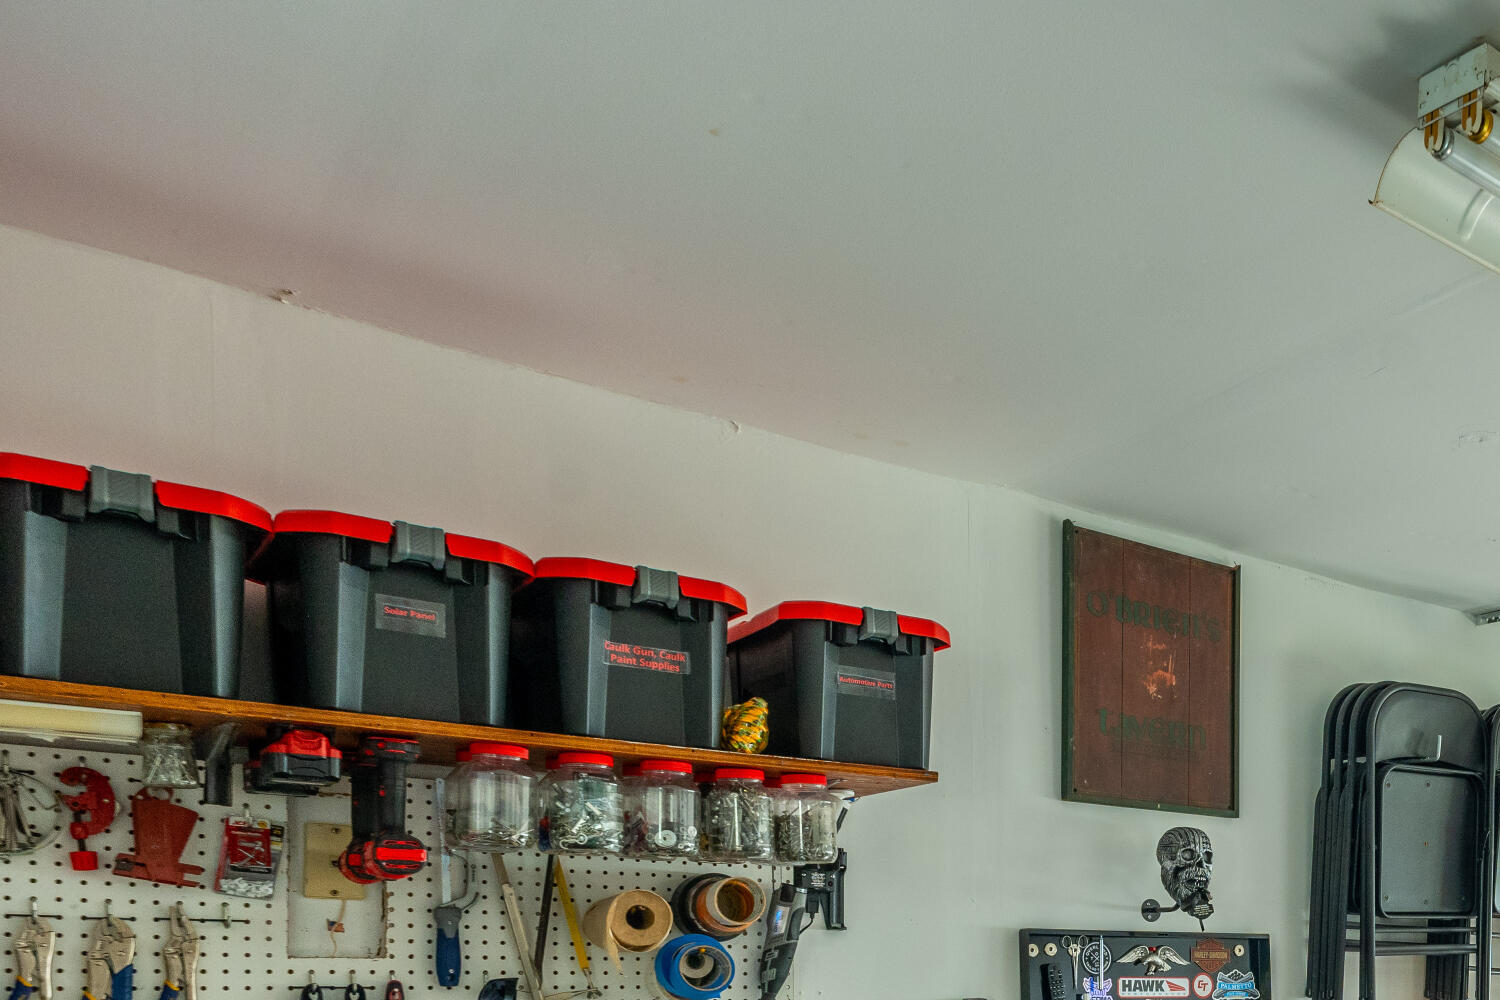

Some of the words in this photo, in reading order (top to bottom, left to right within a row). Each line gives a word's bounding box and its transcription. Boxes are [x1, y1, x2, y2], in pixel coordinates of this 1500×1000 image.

[383, 605, 408, 616] Solar
[409, 609, 436, 621] Panel
[604, 640, 631, 653] Caulk
[633, 645, 657, 659] Gun,
[659, 649, 686, 662] Caulk
[610, 653, 637, 665] Paint
[640, 658, 680, 672] Supplies
[1121, 979, 1165, 992] HAWK
[1220, 982, 1253, 990] PALMETTO
